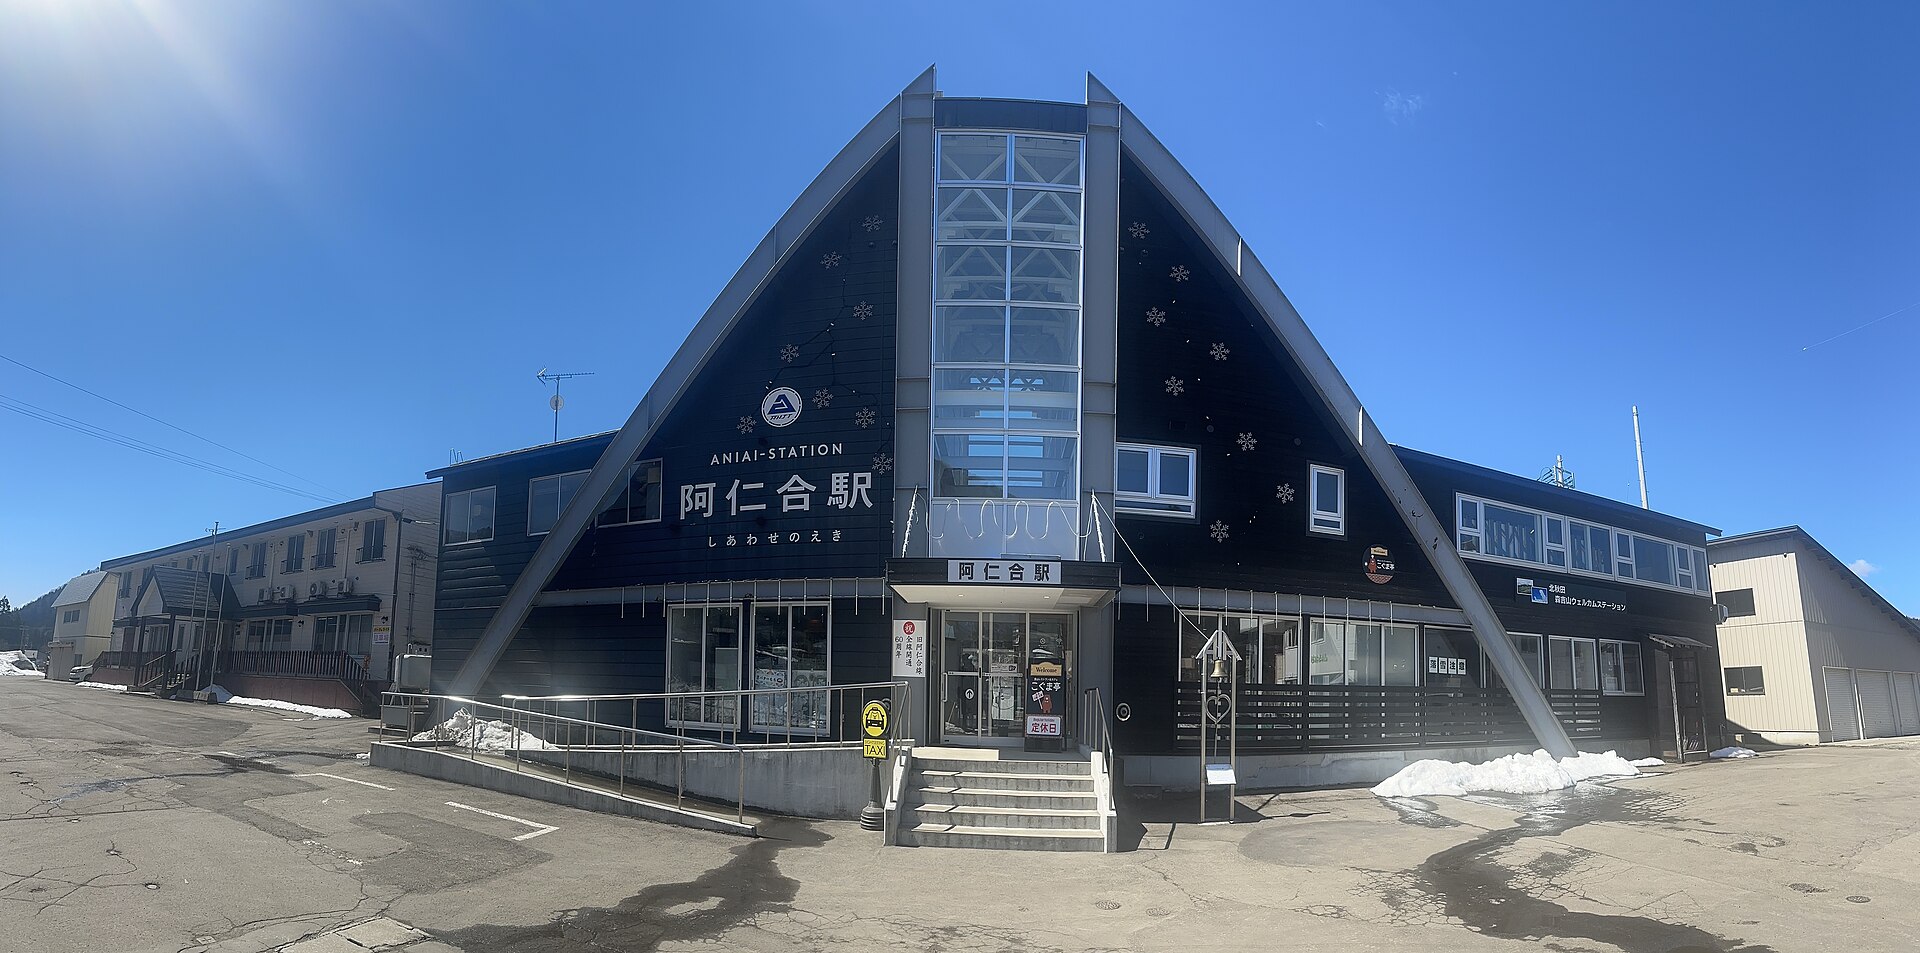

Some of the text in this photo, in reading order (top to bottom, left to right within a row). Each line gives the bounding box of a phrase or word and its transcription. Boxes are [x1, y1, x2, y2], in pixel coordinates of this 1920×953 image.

[710, 442, 843, 465] ANIAI-STATION
[680, 472, 873, 520] 阿仁合駅
[708, 530, 842, 547] しあわせのえき
[959, 562, 1050, 582] 阿仁合駅
[1549, 584, 1566, 594] 北秋田
[1554, 595, 1626, 611] 森吉山ウェルカムステーション
[1031, 681, 1061, 691] こぐま亭
[1031, 722, 1057, 733] 定休日
[865, 745, 886, 756] TAXI
